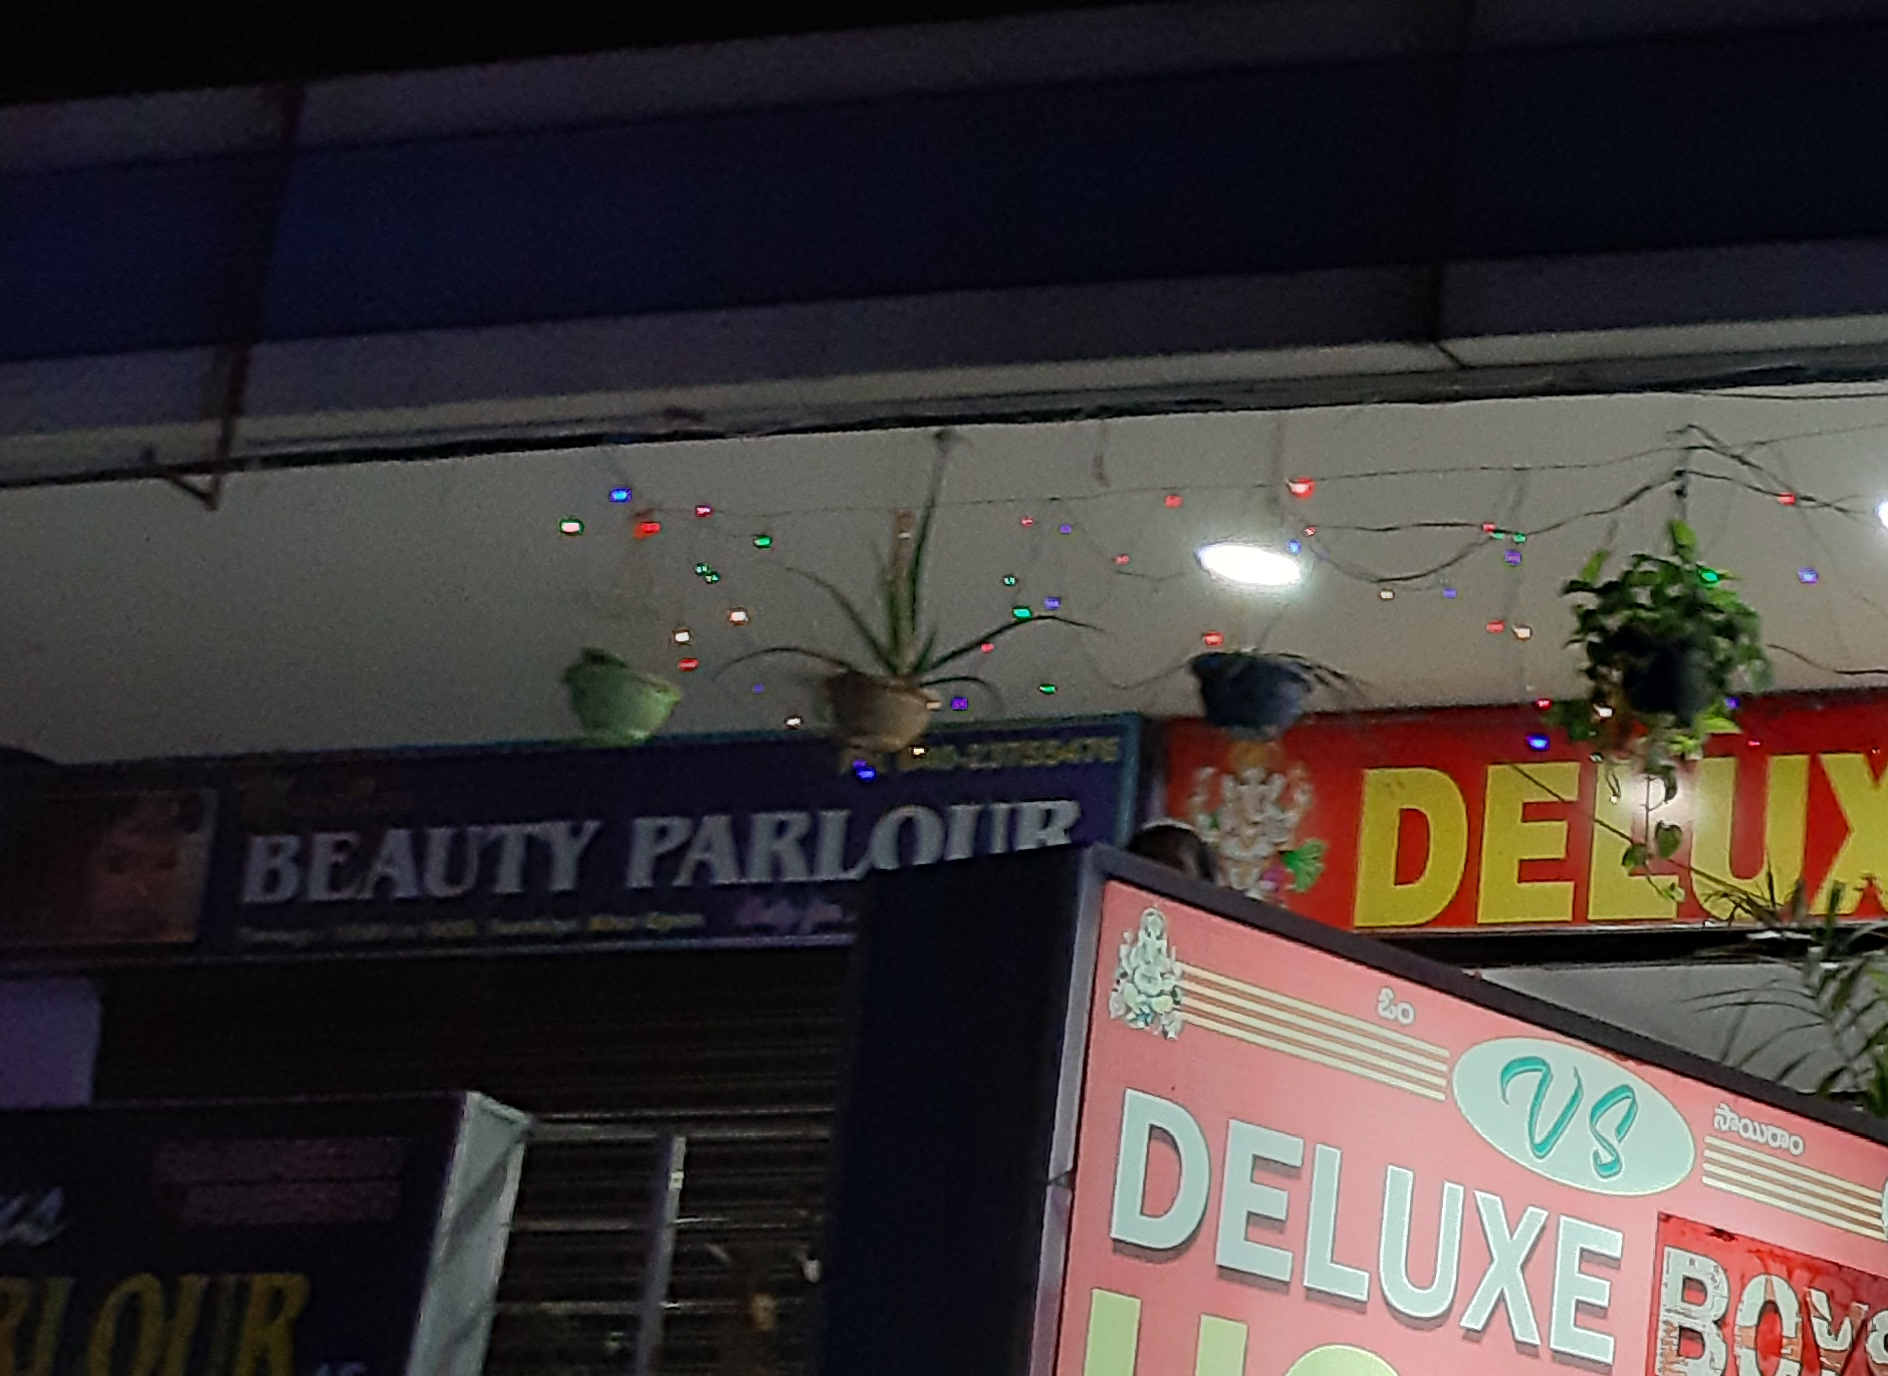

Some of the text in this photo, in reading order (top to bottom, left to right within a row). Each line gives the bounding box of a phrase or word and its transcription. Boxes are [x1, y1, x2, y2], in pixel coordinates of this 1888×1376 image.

[242, 799, 1081, 904] BEAUTY PARLOUR
[1500, 1055, 1639, 1178] VS
[1110, 1088, 1626, 1365] DELUXE
